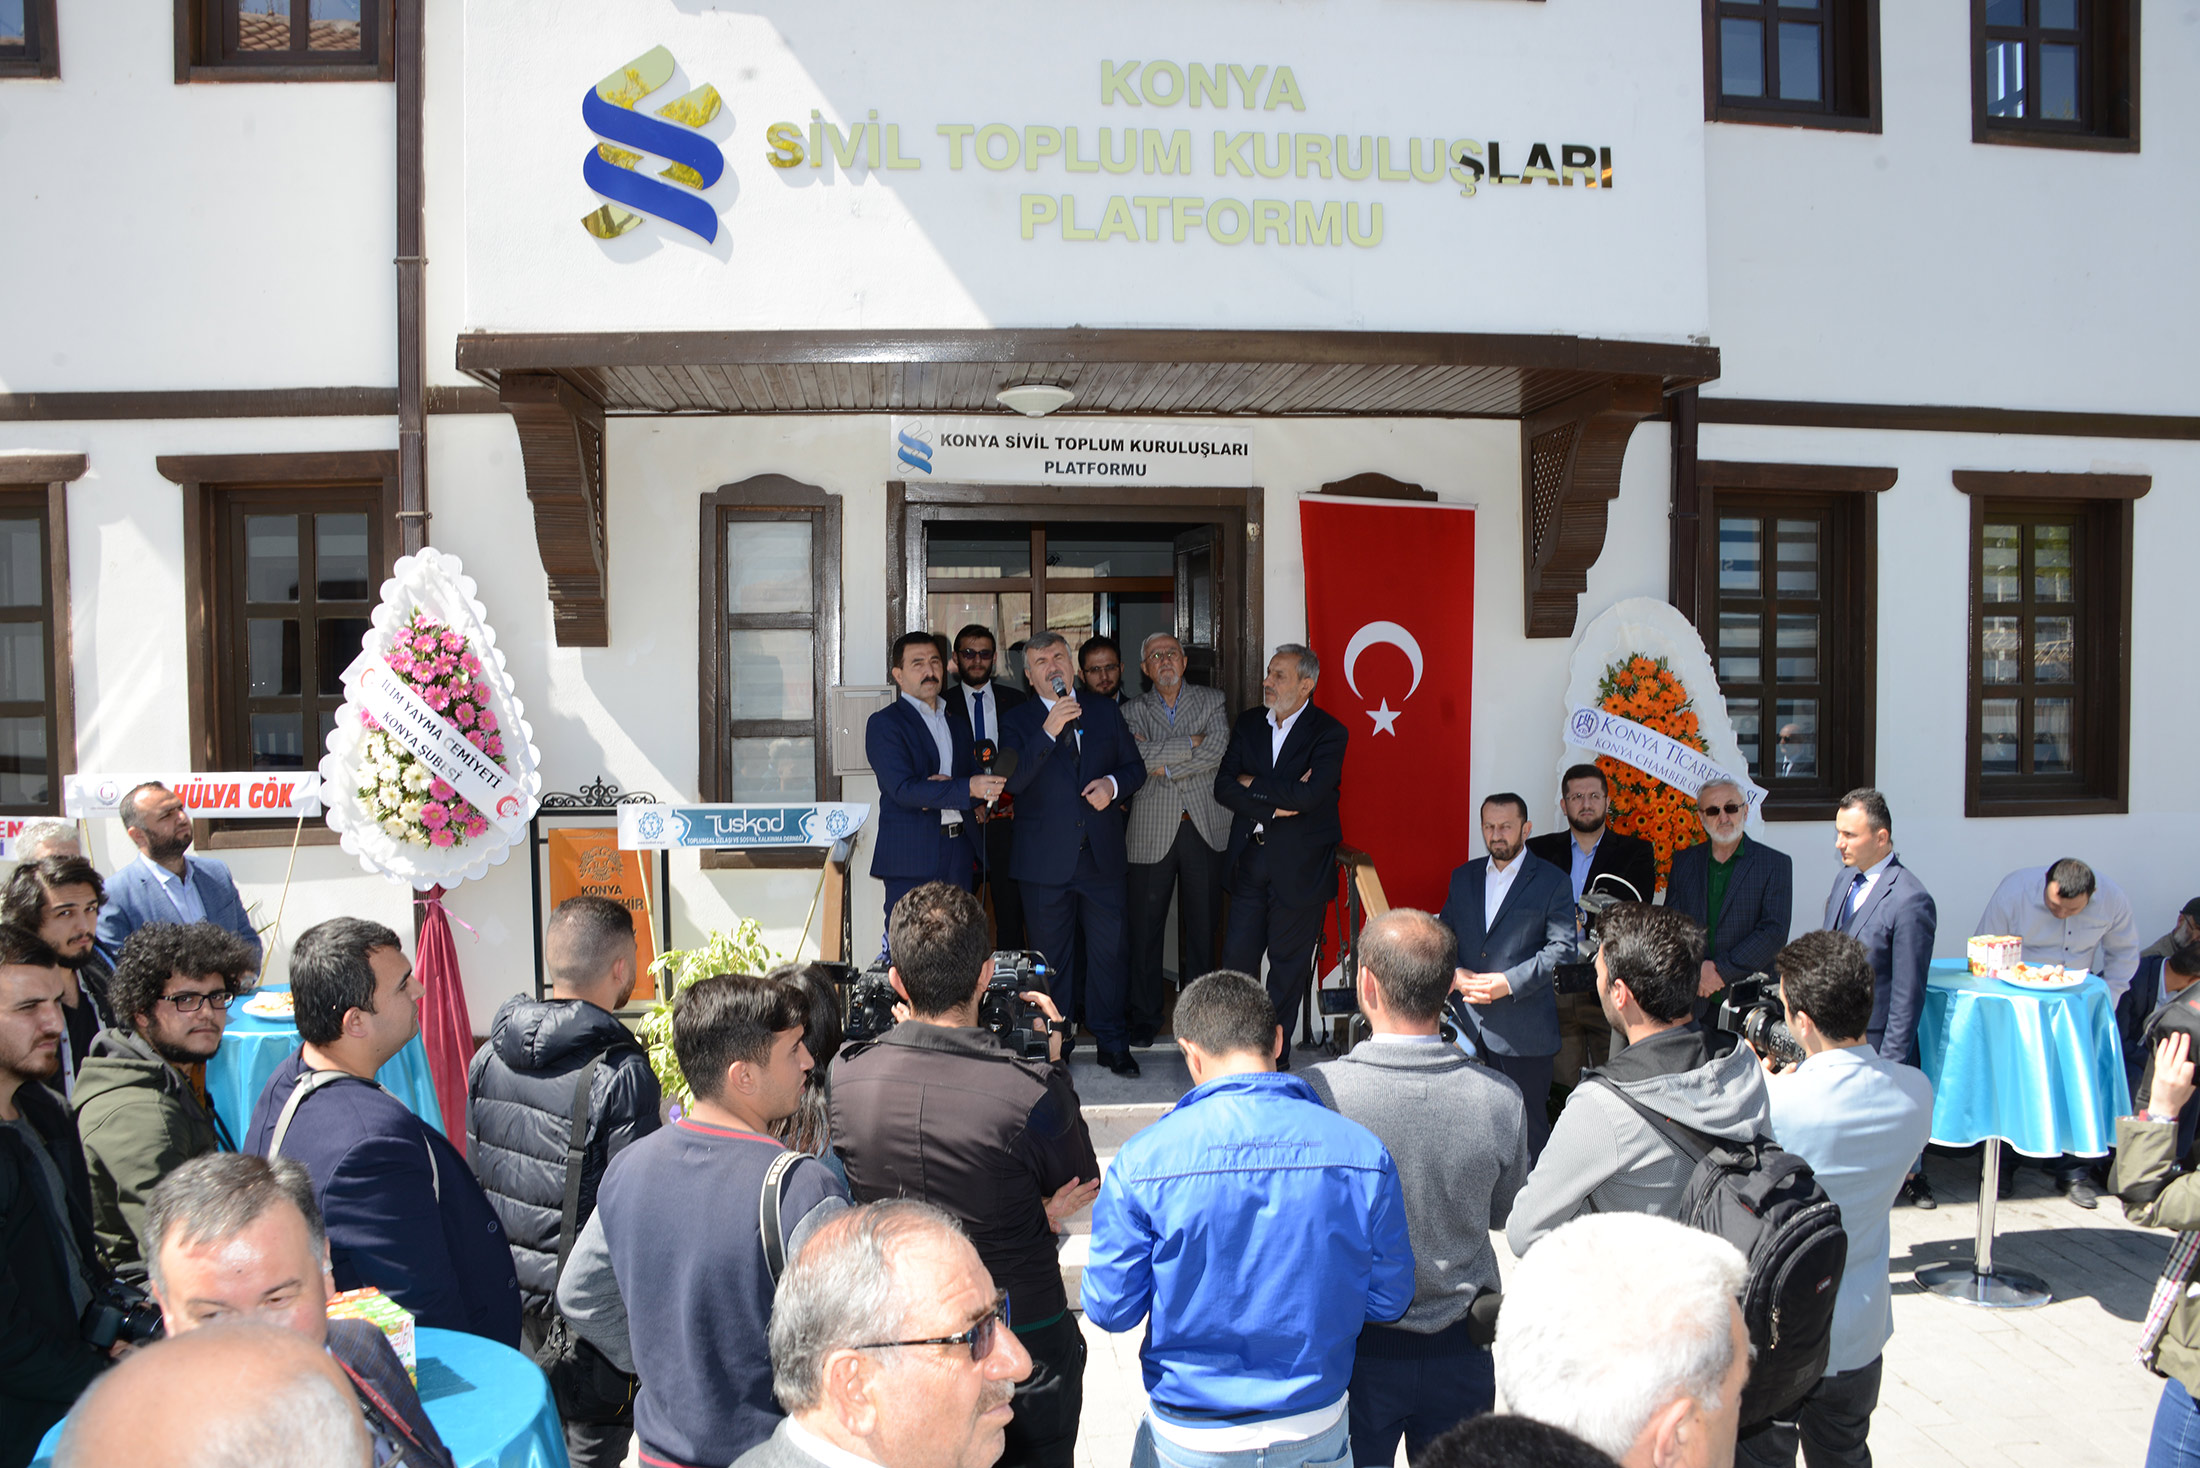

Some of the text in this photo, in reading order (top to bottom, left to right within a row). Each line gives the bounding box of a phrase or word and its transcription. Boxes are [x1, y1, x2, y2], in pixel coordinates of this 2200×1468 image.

[1100, 60, 1306, 111] KONYA
[765, 109, 1613, 198] SİVİL TOPLUM KURULUŞLARI
[1020, 194, 1384, 248] PLATFORMU
[940, 432, 1249, 458] KONYA SİVİL TOPLUM KURULUŞLARI
[1044, 460, 1147, 477] PLATFORMU
[383, 711, 463, 783] KONYA ŞUBESİ
[404, 701, 443, 741] YAYMA
[443, 737, 503, 789] CEMİYETİ
[1601, 716, 1659, 754] KONYA
[1595, 738, 1632, 759] KONYA
[1635, 753, 1687, 787] CHAMBER
[173, 776, 295, 809] HÜLYA GÖK
[581, 885, 622, 896] KONYA
